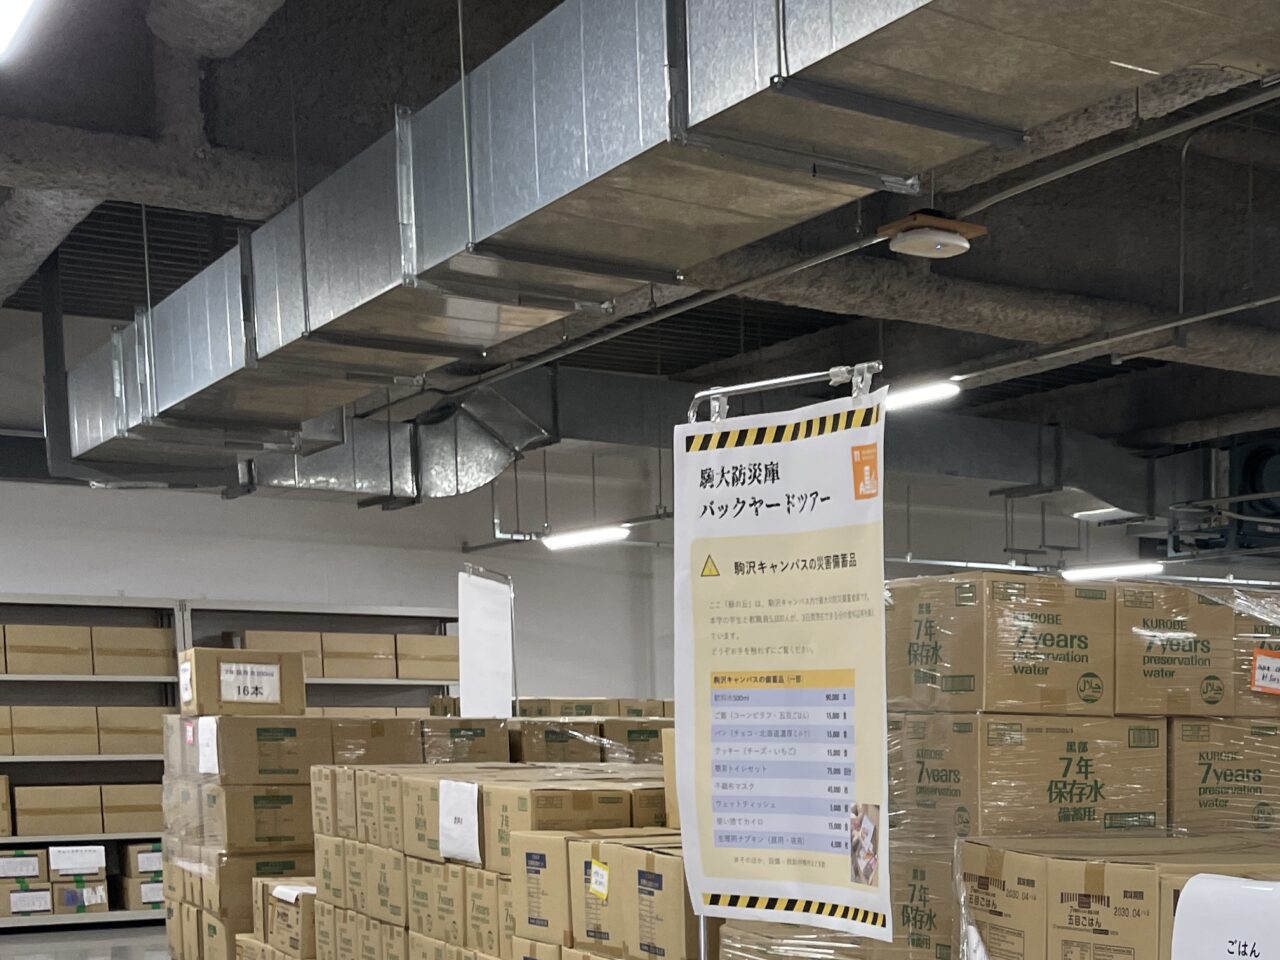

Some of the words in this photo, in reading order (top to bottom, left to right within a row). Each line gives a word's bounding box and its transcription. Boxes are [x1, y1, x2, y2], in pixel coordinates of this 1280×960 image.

[699, 461, 781, 489] 駒大防災庫
[699, 490, 831, 519] バックヤードツアー
[734, 552, 857, 576] 駒沢キャンパスの災害備蓄品
[1142, 617, 1188, 631] KUROBE
[908, 642, 942, 665] 保存水
[1143, 655, 1211, 668] preservation
[1013, 664, 1050, 676] water
[1143, 668, 1176, 679] water
[237, 685, 263, 698] 16本
[915, 760, 961, 784] 7years
[1059, 756, 1096, 780] 7年
[1199, 763, 1263, 785] 7years
[1046, 780, 1107, 804] 保存水
[907, 884, 930, 908] 7年
[901, 904, 937, 932] 保存水
[1226, 939, 1261, 959] ごはん
